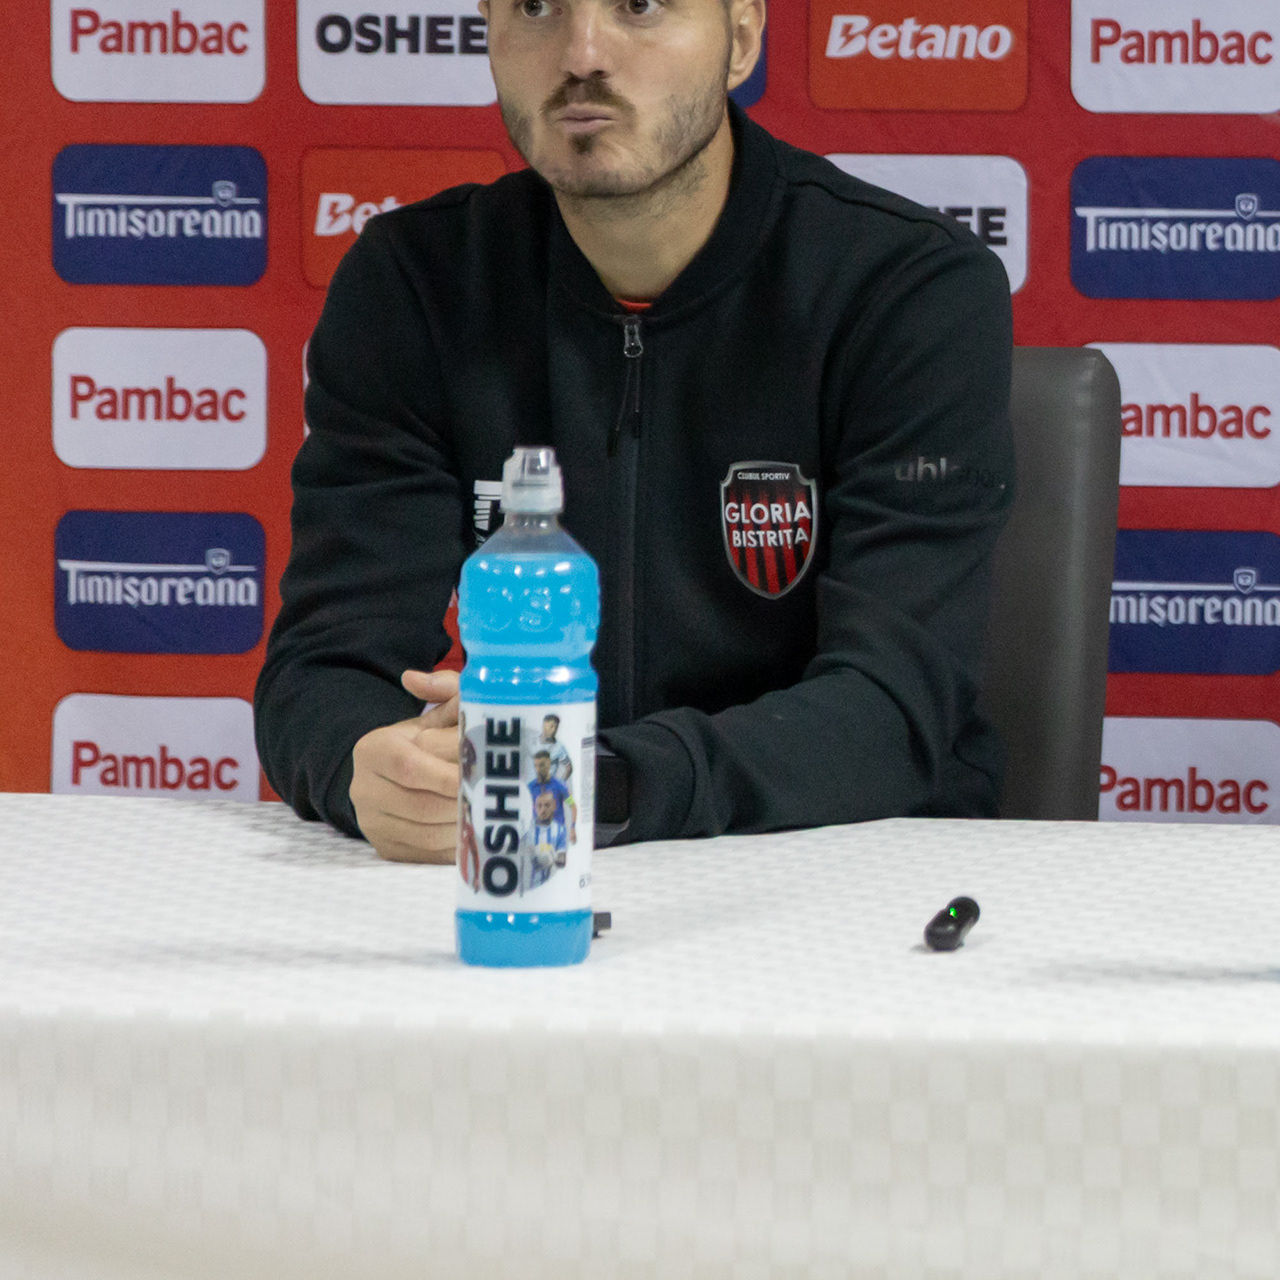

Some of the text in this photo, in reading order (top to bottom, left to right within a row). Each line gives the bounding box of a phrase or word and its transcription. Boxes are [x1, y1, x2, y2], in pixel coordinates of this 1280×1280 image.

[70, 8, 248, 56] Pambac
[315, 14, 489, 56] OSHEE
[825, 14, 1013, 60] Betano
[1090, 18, 1273, 66] Pambac
[69, 374, 247, 423] Pambac
[1120, 392, 1272, 441] ambac
[724, 501, 812, 525] GLORIA
[732, 527, 810, 550] BISTRIȚA
[71, 740, 239, 792] Pambac
[482, 716, 521, 898] OSHEE
